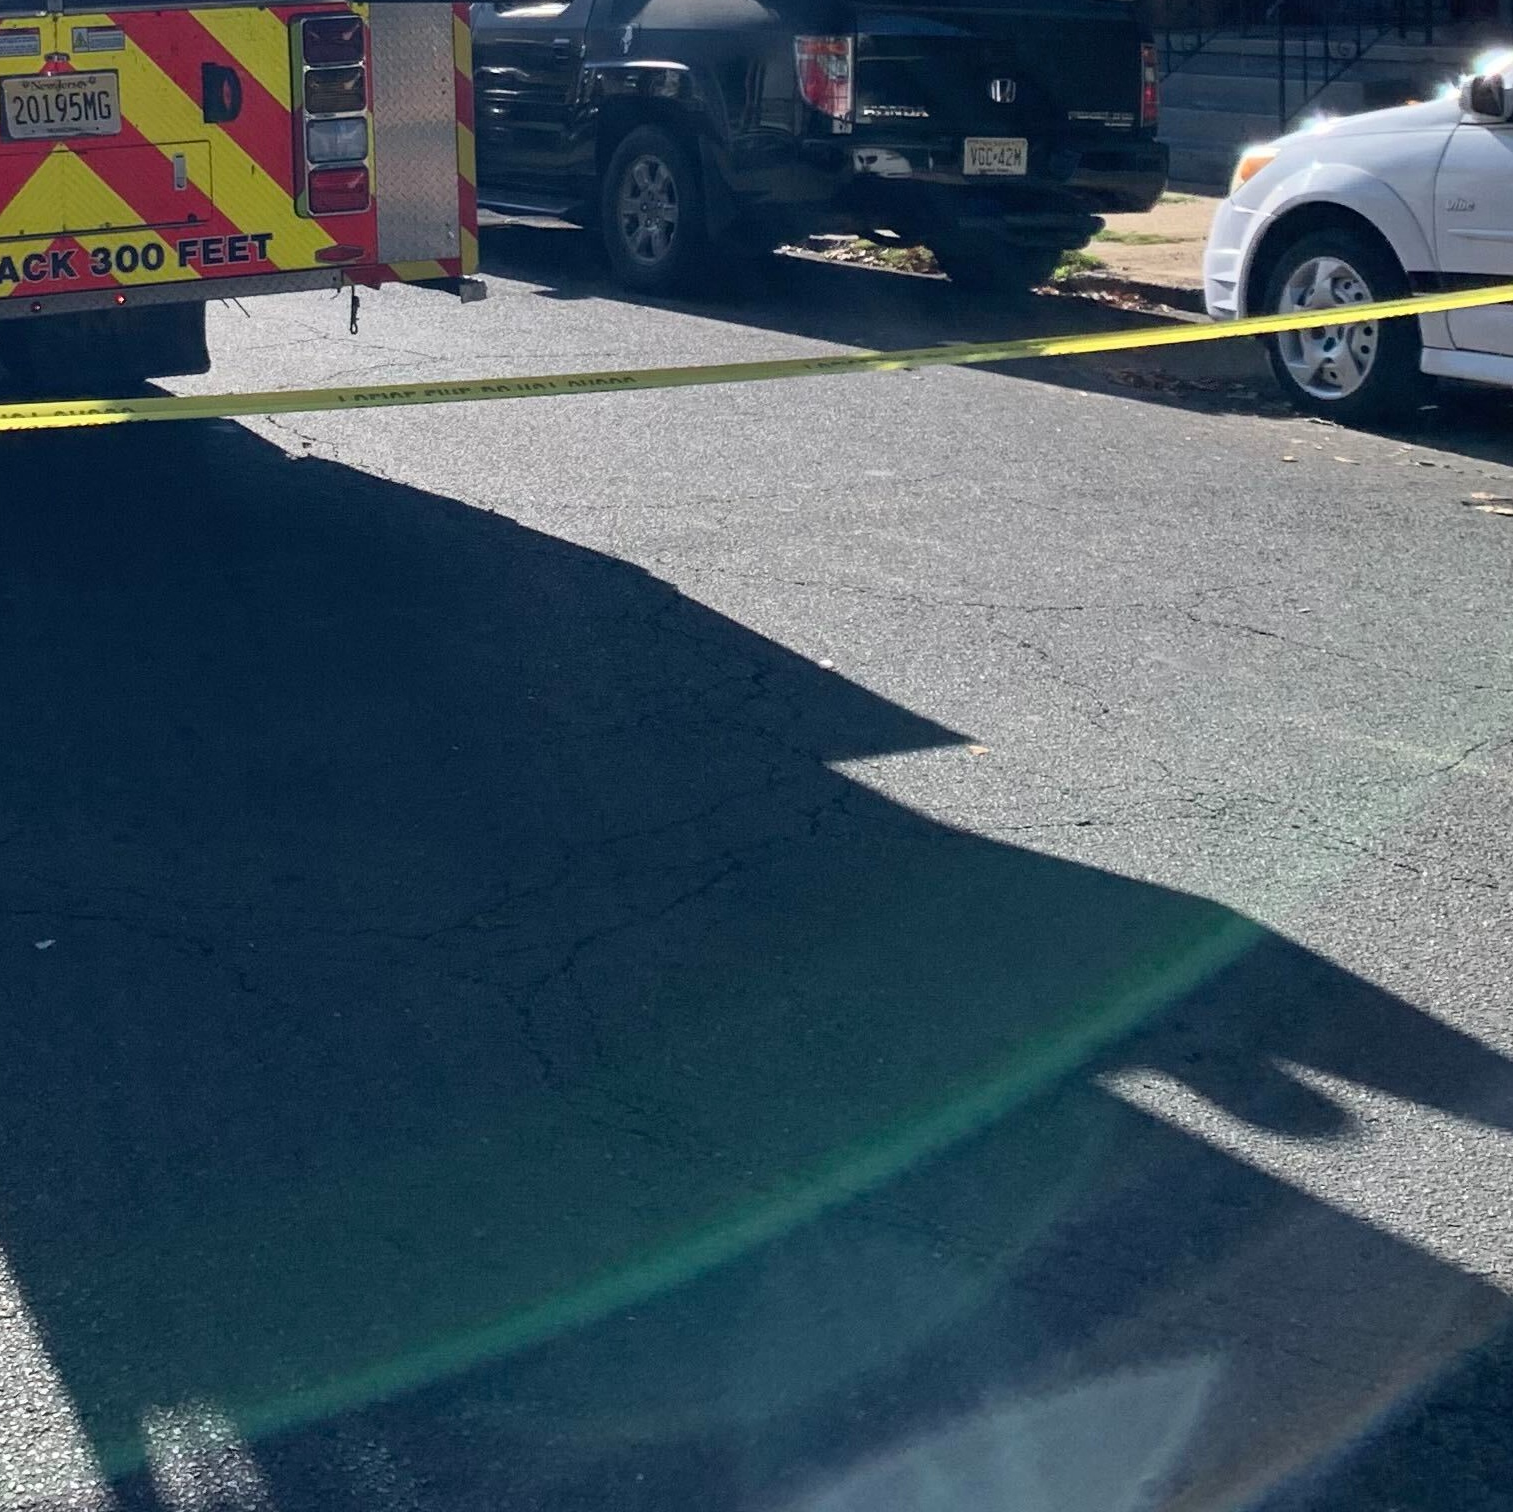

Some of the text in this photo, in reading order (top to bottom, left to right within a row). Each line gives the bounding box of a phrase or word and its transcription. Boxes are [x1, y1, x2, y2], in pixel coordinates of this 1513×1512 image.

[13, 90, 111, 125] 20195MG
[91, 243, 165, 276] 300
[178, 233, 273, 267] FEET
